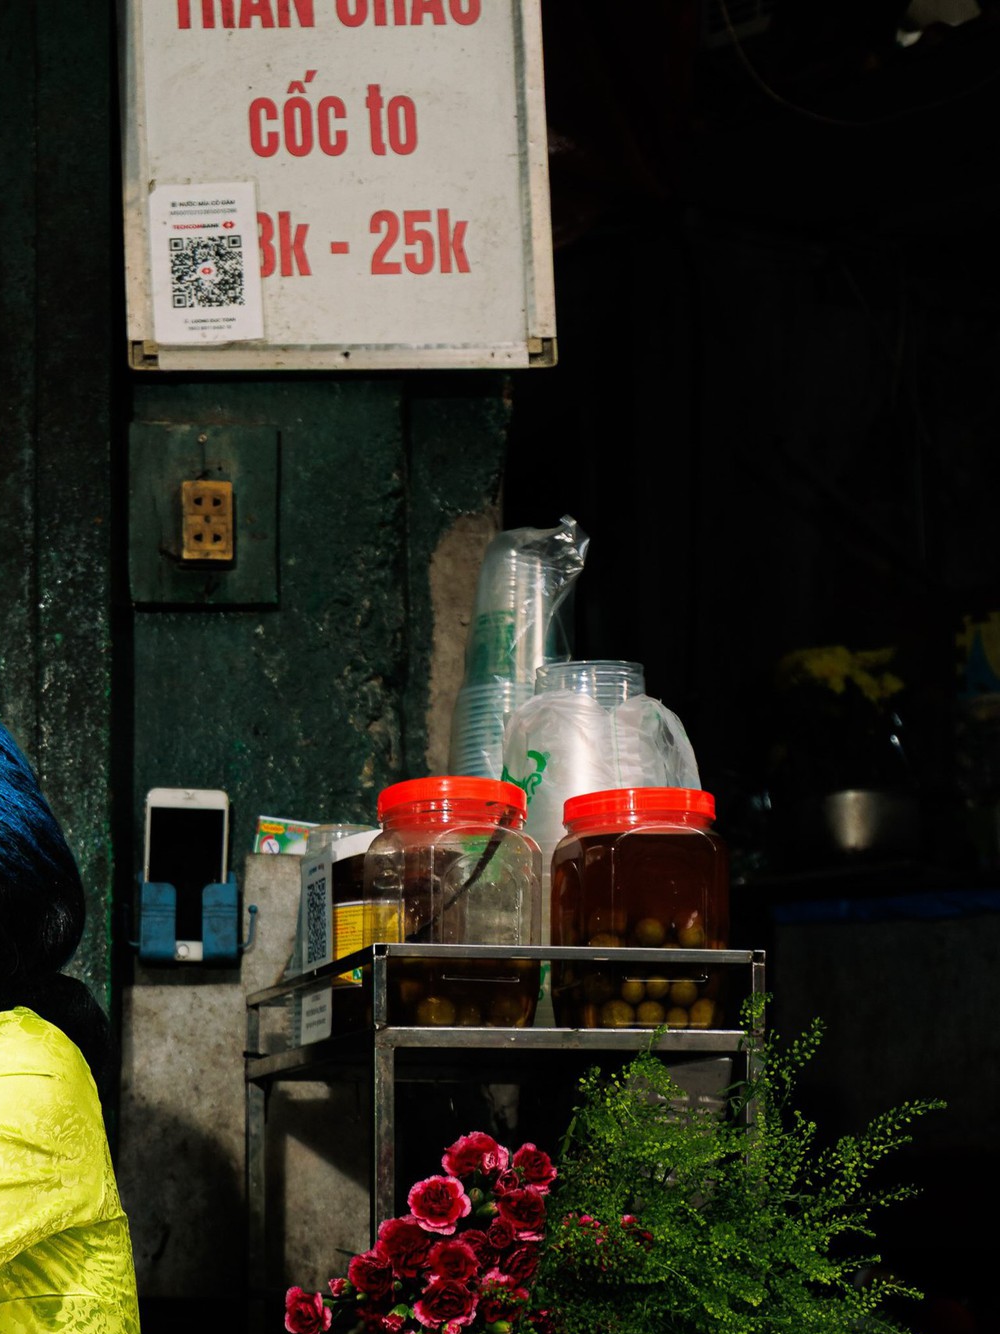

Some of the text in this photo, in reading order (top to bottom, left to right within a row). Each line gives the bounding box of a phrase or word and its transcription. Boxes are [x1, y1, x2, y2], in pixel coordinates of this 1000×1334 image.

[248, 70, 418, 158] cốc to
[369, 208, 471, 275] 25k
